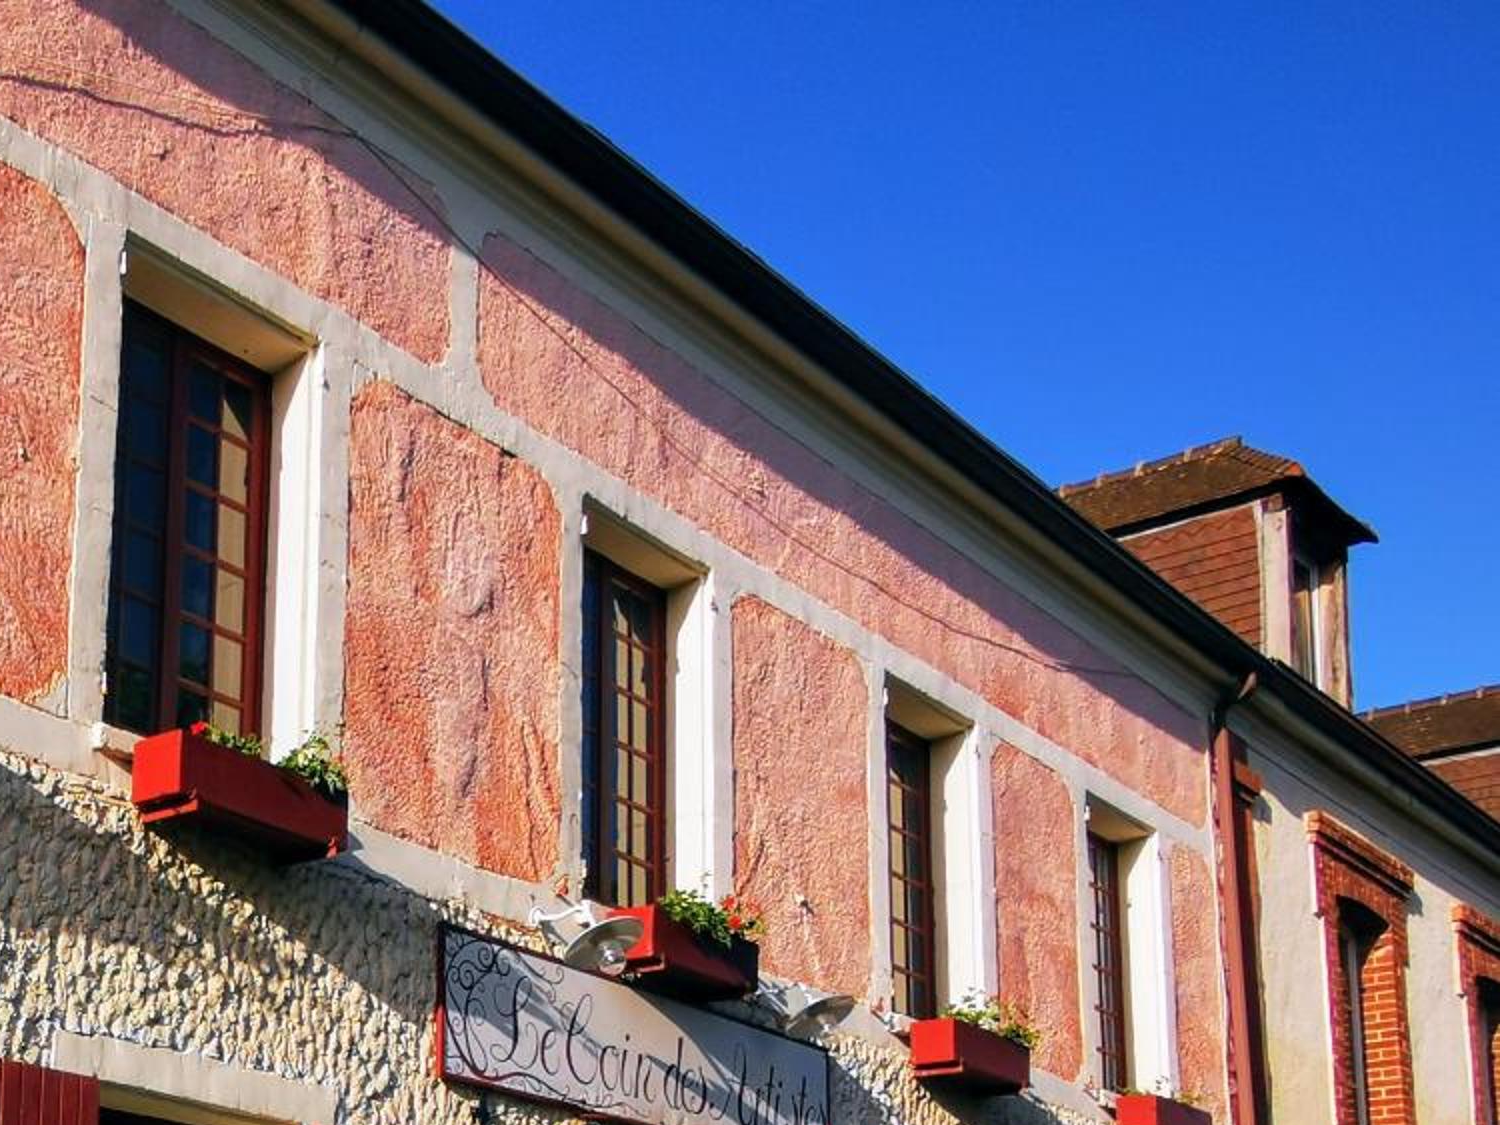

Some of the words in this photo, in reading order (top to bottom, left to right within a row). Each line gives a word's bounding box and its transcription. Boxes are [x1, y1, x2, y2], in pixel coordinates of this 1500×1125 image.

[488, 973, 560, 1076] Le
[561, 993, 656, 1103] Coin
[663, 1036, 707, 1116] des
